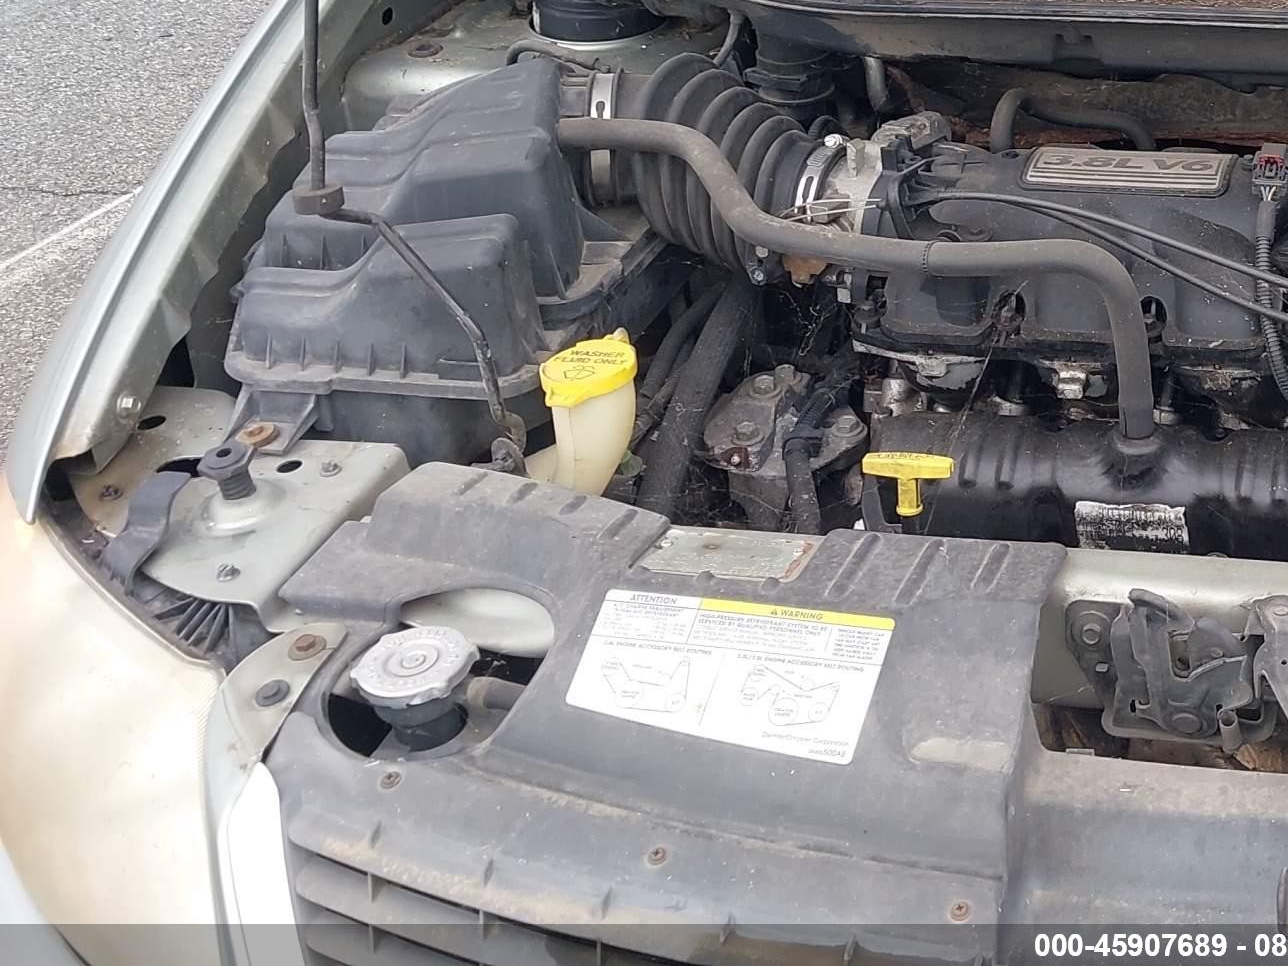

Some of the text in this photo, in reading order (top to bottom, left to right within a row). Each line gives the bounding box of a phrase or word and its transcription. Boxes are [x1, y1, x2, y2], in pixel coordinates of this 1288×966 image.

[1043, 153, 1214, 172] 3.8L V6
[570, 349, 625, 358] WASHER
[630, 593, 678, 605] ATTENTION
[780, 609, 824, 621] WARNING
